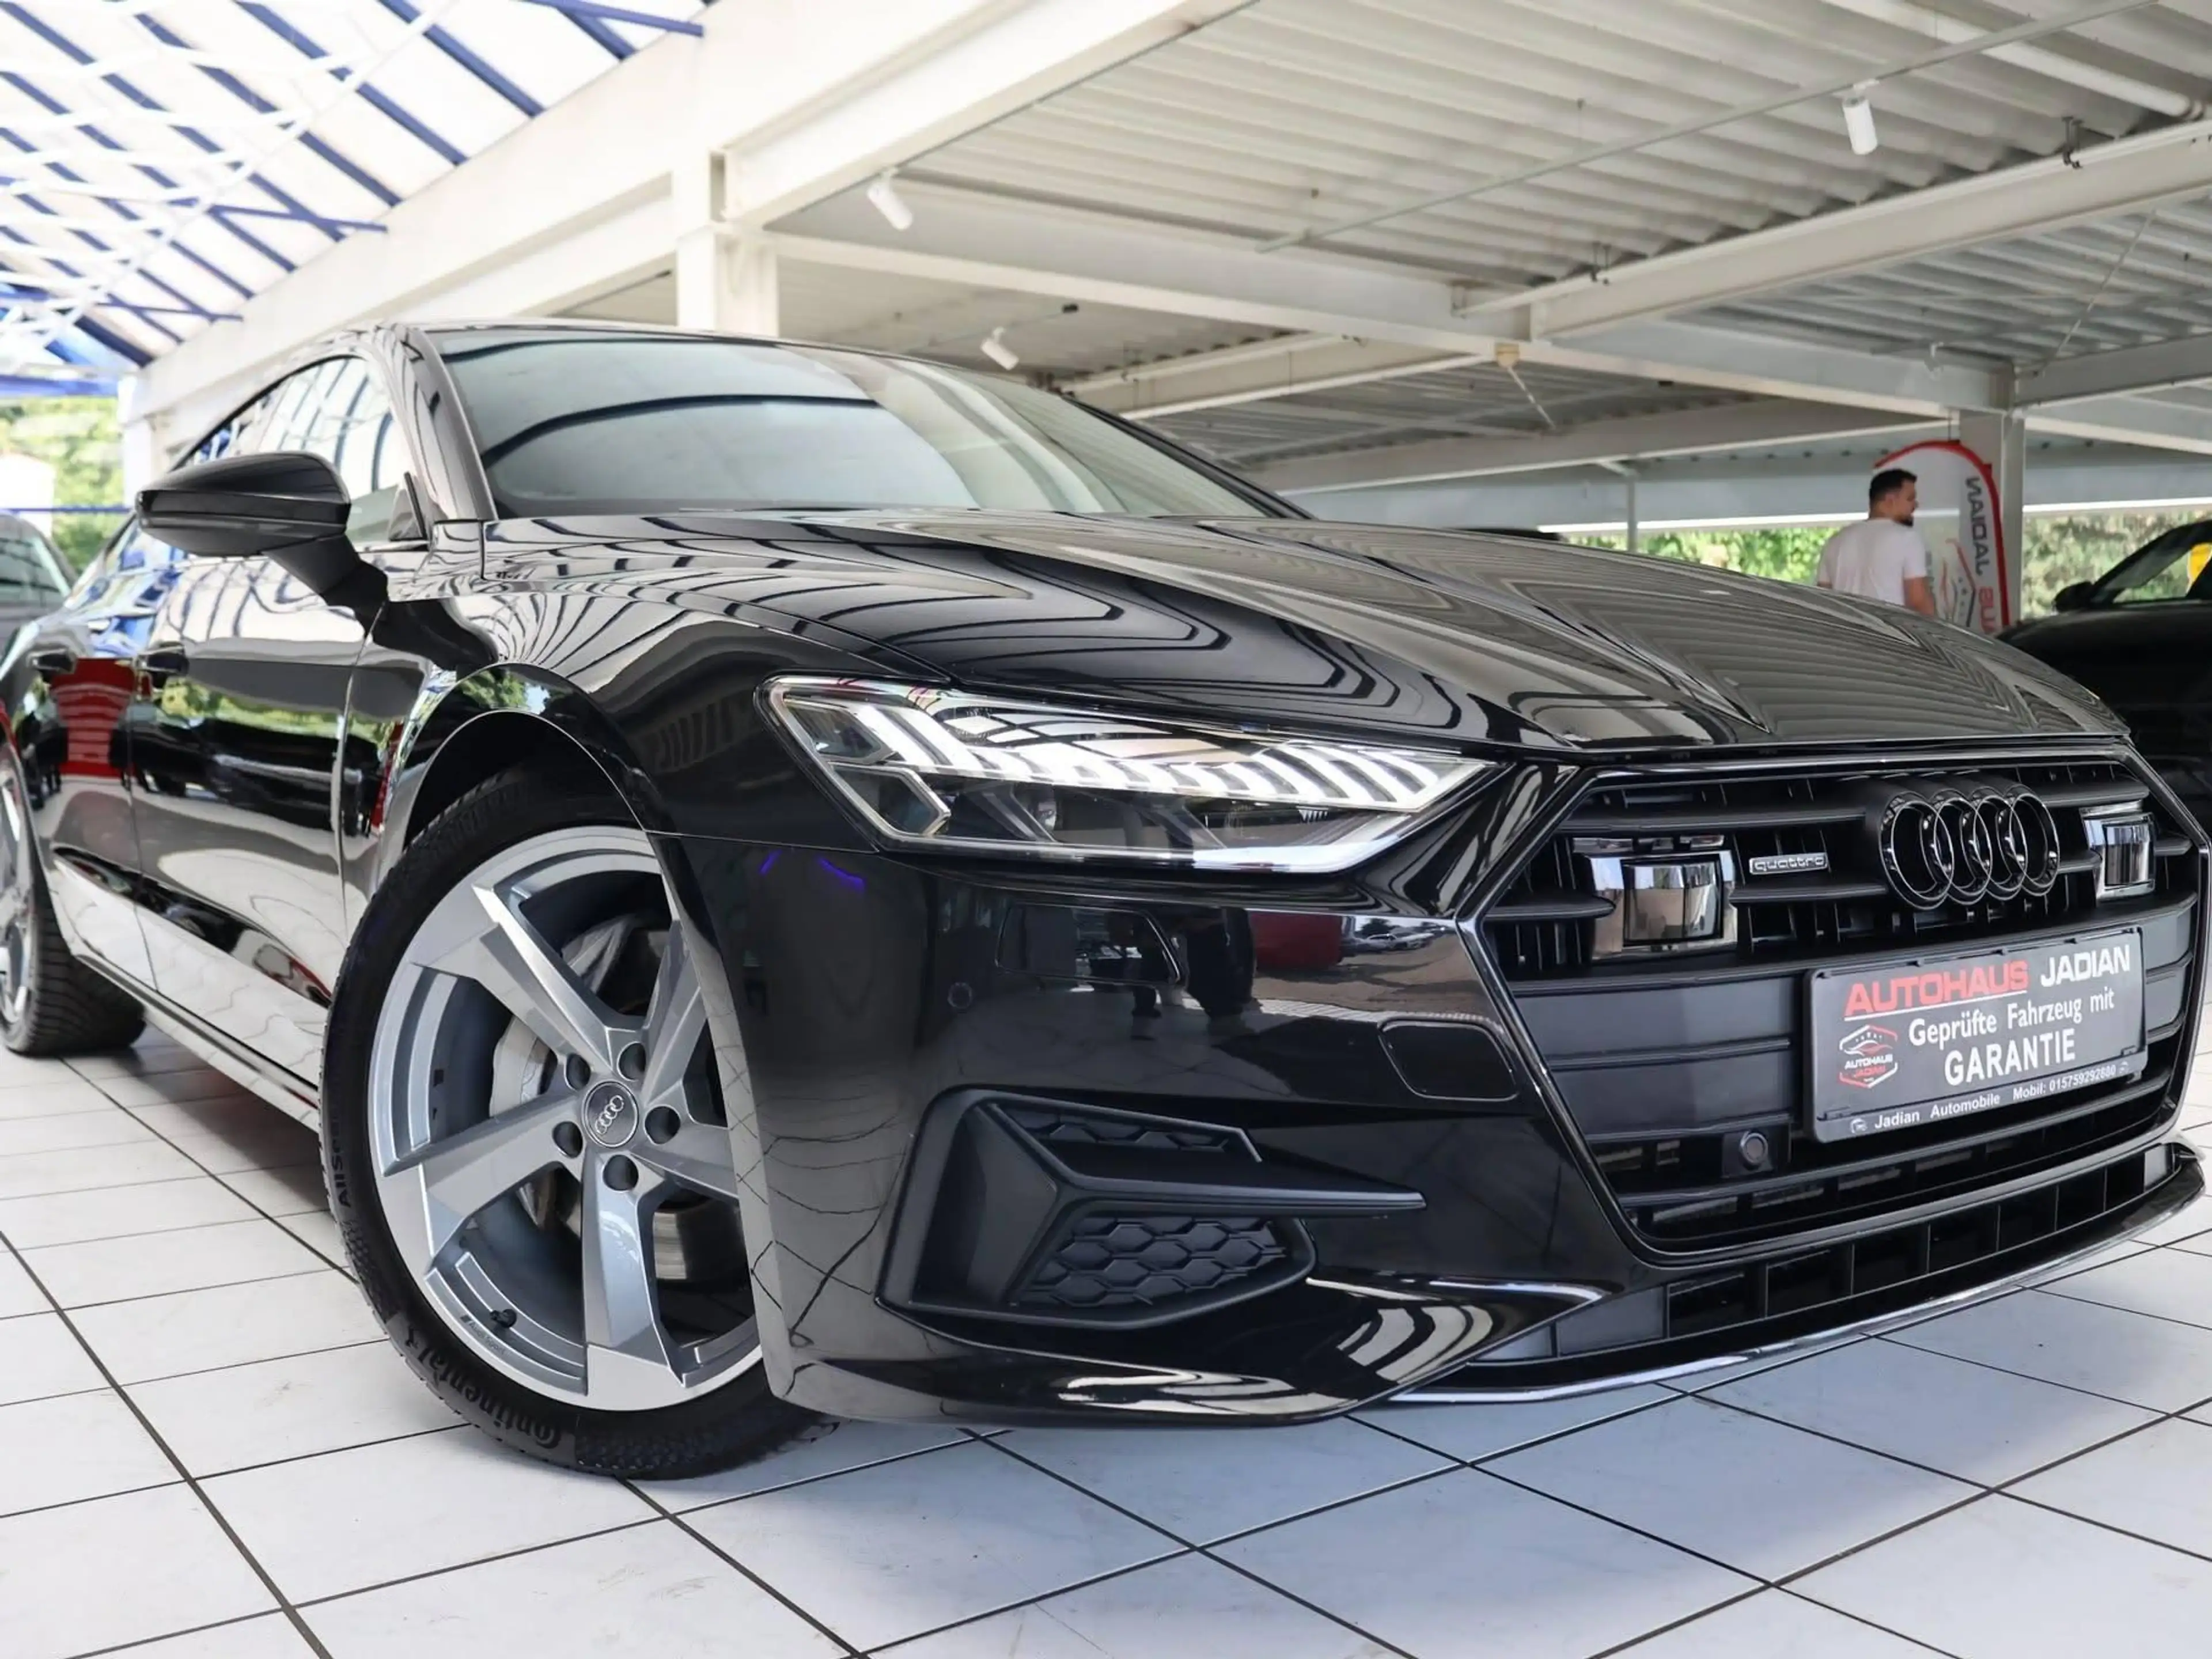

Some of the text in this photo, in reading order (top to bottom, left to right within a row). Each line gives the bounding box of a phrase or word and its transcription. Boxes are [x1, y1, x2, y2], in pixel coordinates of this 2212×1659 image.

[1754, 857, 1824, 872] quattro
[1844, 944, 2130, 1016] AUTOHAUS JADIAN
[1909, 986, 2115, 1050] Geprüfte Fahrzeug mit
[1944, 1028, 2075, 1086] GARANTIE
[1875, 1111, 1920, 1129] Jadian
[1930, 1093, 2001, 1119] Automobile
[2013, 1082, 2046, 1101] Mobil:
[418, 1347, 561, 1449] Continental
